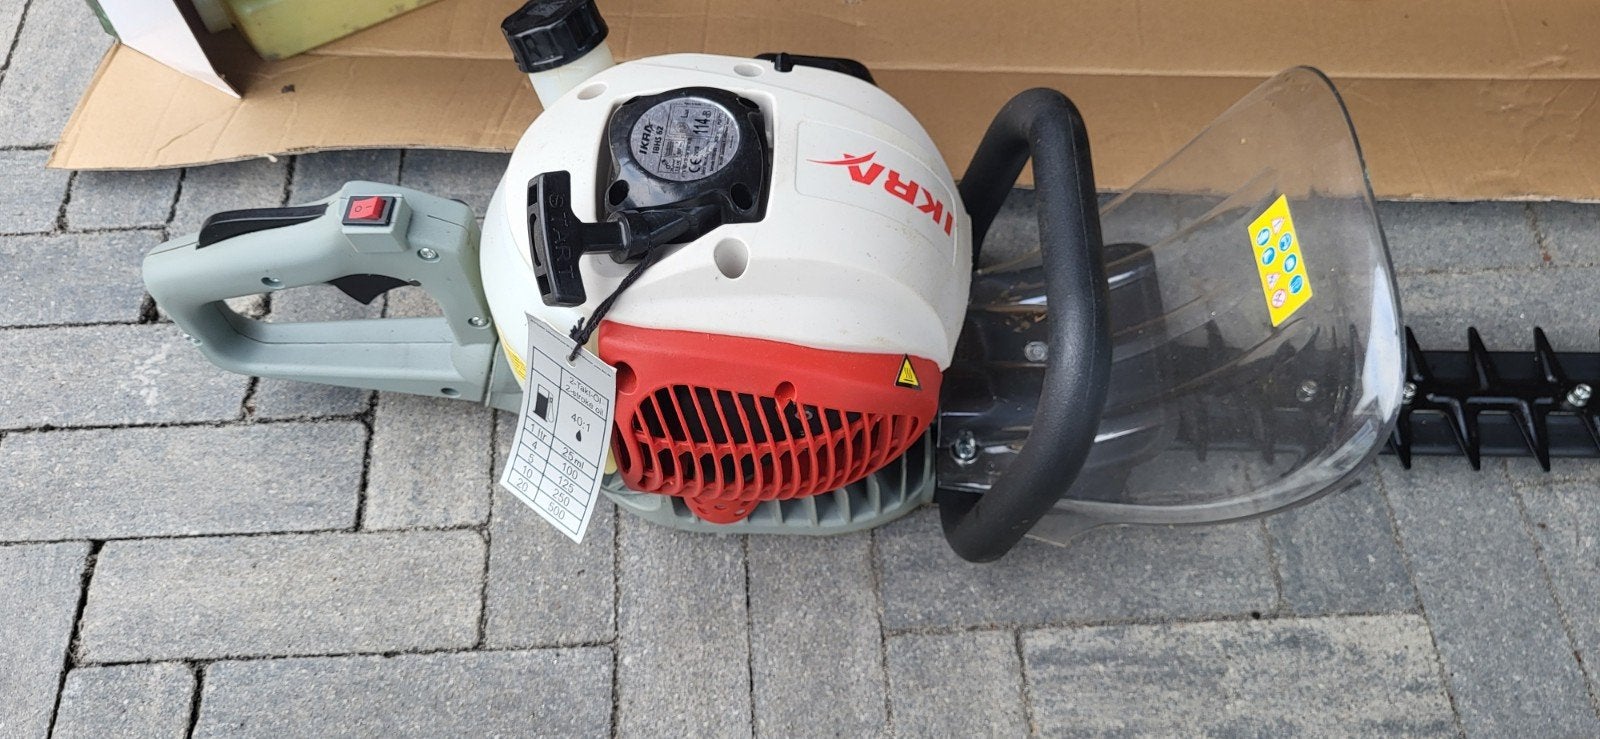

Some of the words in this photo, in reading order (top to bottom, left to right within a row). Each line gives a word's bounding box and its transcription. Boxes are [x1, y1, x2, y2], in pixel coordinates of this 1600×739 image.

[658, 125, 664, 135] 62
[693, 118, 710, 135] 114
[638, 121, 653, 155] IKRA
[688, 159, 702, 173] CE
[806, 150, 953, 237] IKRA
[548, 192, 575, 279] START
[565, 385, 594, 409] 2-stroke
[594, 406, 604, 416] oil
[530, 423, 535, 432] 1
[538, 428, 547, 440] ltr
[571, 413, 591, 433] 40:1
[531, 441, 538, 450] 4
[528, 453, 535, 464] 5
[562, 447, 574, 461] 25
[574, 459, 585, 469] ml
[522, 465, 533, 479] 10
[562, 462, 579, 480] 100
[516, 478, 529, 492] 20
[558, 476, 576, 493] 125
[552, 488, 571, 507] 250
[547, 501, 566, 520] 500
